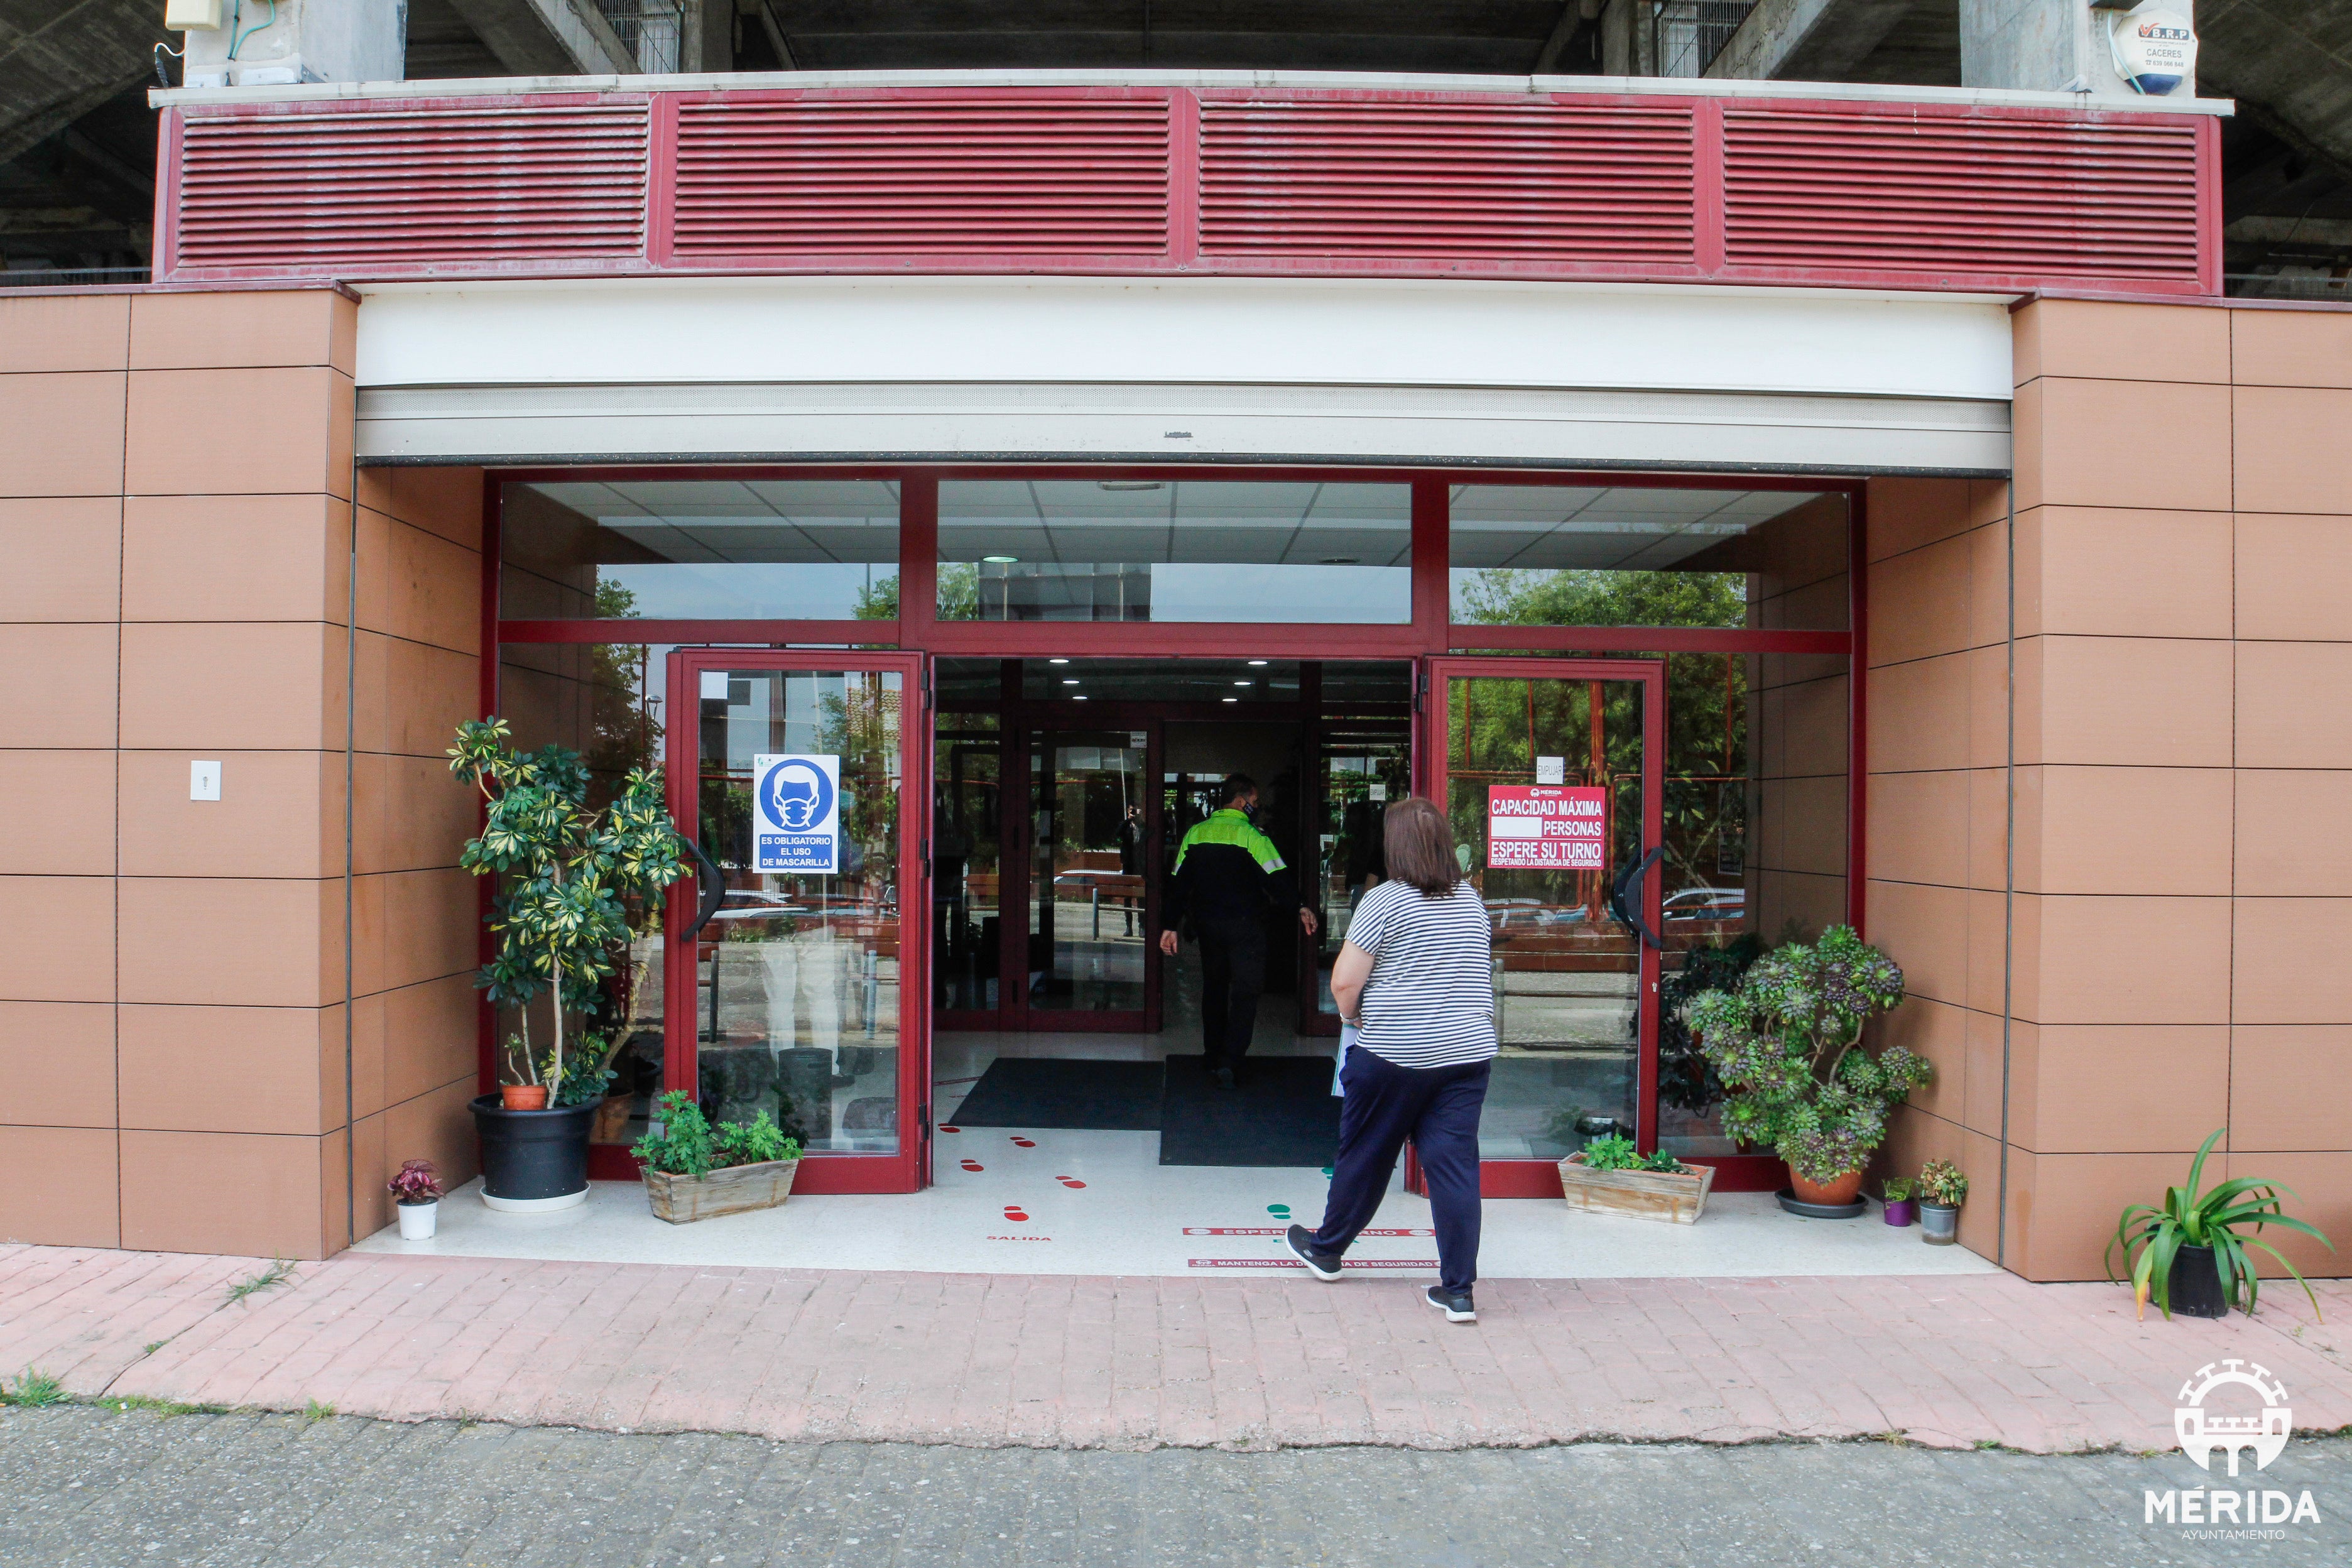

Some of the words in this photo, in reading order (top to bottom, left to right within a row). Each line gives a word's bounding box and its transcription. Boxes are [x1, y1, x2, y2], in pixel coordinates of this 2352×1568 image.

[2147, 48, 2182, 58] CACERES
[1538, 765, 1562, 776] EMPUJAR
[1491, 799, 1556, 815] CAPACIDAD
[1559, 797, 1602, 816] MÁXIMA
[1544, 820, 1601, 836] PERSONAS
[761, 837, 772, 845] ES
[774, 837, 830, 845] OBLIGATORIO
[1491, 842, 1538, 858] ESPERE
[1541, 842, 1557, 859] SU
[1560, 842, 1601, 859] TURNO
[776, 858, 829, 866] MASCARILLA
[1571, 859, 1601, 867] SEGURIDAD
